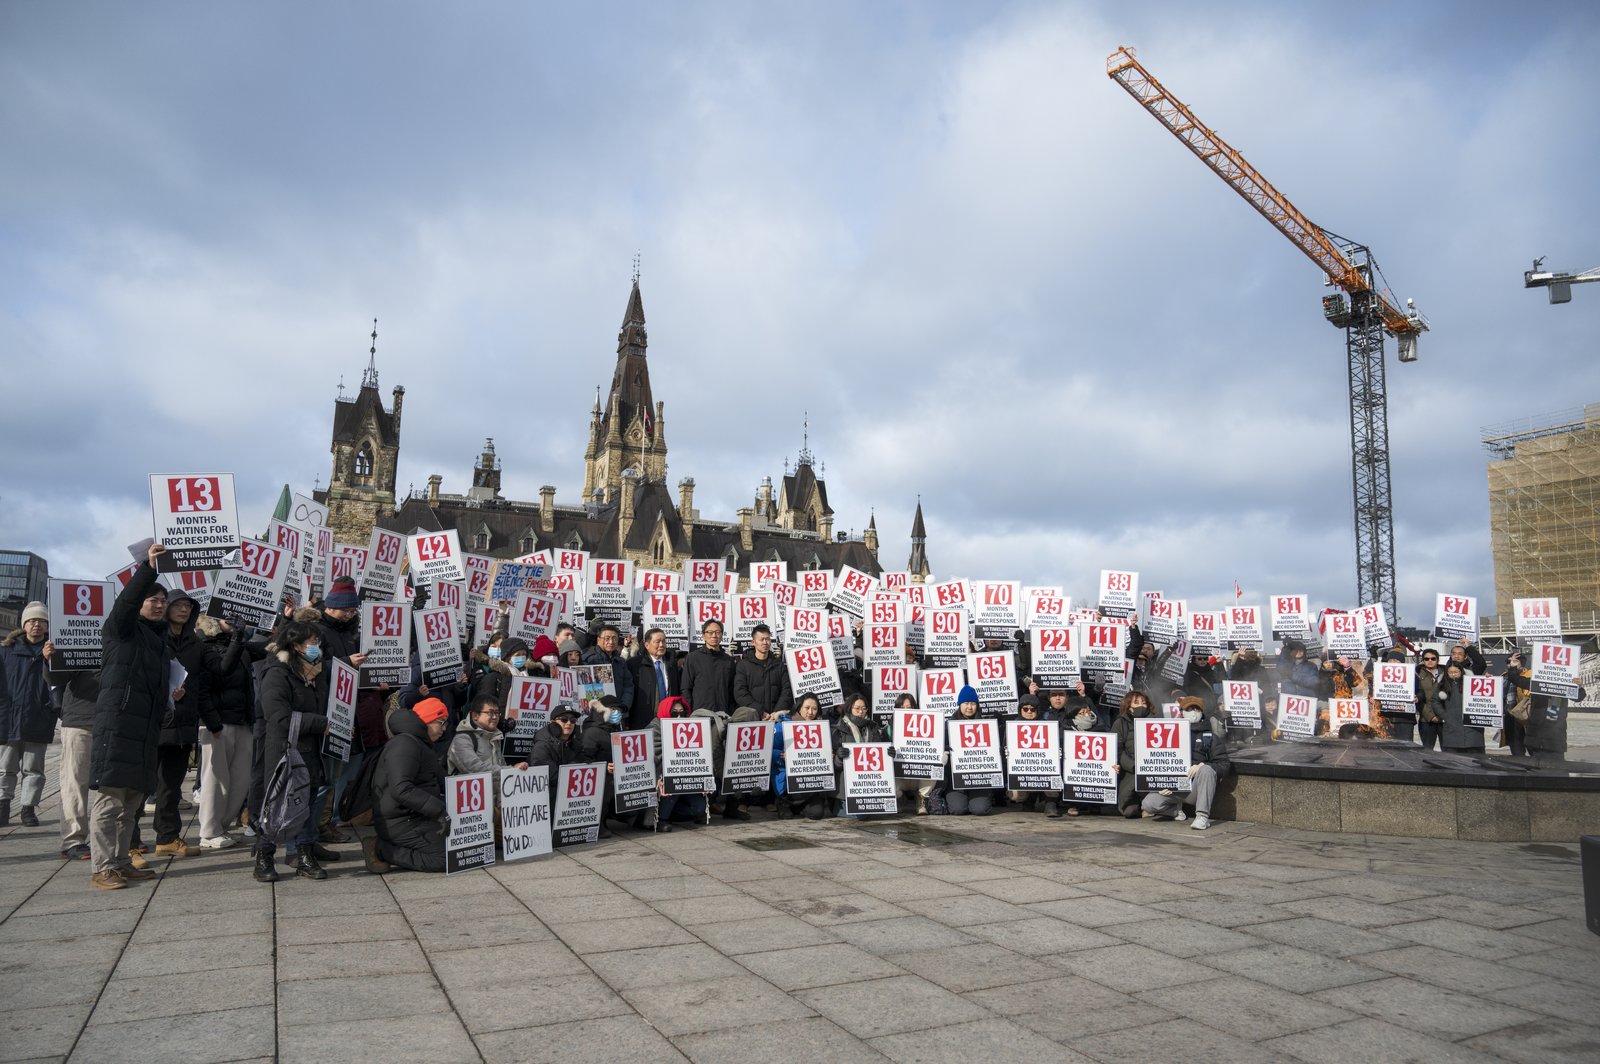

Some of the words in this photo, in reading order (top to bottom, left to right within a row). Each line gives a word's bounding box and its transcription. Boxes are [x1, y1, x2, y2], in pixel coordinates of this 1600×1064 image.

[175, 477, 214, 512] 13
[176, 515, 217, 524] MONTHS
[166, 526, 207, 535] WAITING
[209, 524, 228, 533] FOR
[161, 537, 183, 546] IRCC
[184, 534, 234, 545] RESPONSE
[319, 532, 329, 556] 20
[378, 536, 399, 563] 36
[422, 535, 448, 559] 42
[172, 551, 185, 559] NO
[176, 559, 188, 567] NO
[240, 543, 277, 577] 30
[424, 560, 449, 568] MONTHS
[564, 553, 581, 569] 31
[419, 567, 444, 576] WAITING
[500, 564, 522, 575] STOP
[525, 566, 543, 577] THE
[600, 563, 620, 583] 11
[695, 563, 716, 581] 53
[759, 566, 778, 582] 25
[224, 580, 257, 594] WAITING
[257, 588, 273, 598] FOR
[235, 574, 268, 588] MONTHS
[648, 574, 669, 590] 15
[806, 574, 826, 590] 33
[847, 572, 869, 595] 33
[889, 575, 904, 588] 20
[1110, 573, 1128, 590] 38
[76, 585, 91, 615] 8
[217, 587, 235, 598] IRCC
[235, 592, 275, 607] RESPONSE
[441, 583, 458, 608] 40
[776, 585, 793, 604] 68
[941, 584, 962, 604] 33
[987, 584, 1009, 603] 70
[527, 599, 549, 624] 54
[654, 595, 676, 615] 71
[702, 602, 723, 622] 53
[743, 598, 764, 618] 63
[875, 603, 895, 622] 55
[1038, 599, 1061, 614] 35
[1152, 600, 1169, 617] 32
[1279, 598, 1300, 613] 31
[1447, 597, 1466, 613] 37
[1526, 601, 1546, 618] 11
[68, 619, 100, 627] MONTHS
[375, 606, 399, 635] 34
[426, 611, 448, 640] 38
[797, 611, 818, 631] 68
[936, 612, 956, 632] 90
[1194, 615, 1212, 630] 37
[1234, 609, 1253, 623] 37
[1336, 617, 1356, 632] 34
[874, 628, 895, 647] 34
[1043, 629, 1066, 650] 22
[1093, 626, 1112, 647] 11
[799, 648, 825, 672] 39
[1545, 646, 1567, 665] 14
[979, 656, 1002, 678] 65
[1385, 666, 1403, 682] 39
[338, 667, 353, 704] 37
[884, 670, 906, 689] 40
[929, 673, 953, 693] 72
[1473, 678, 1491, 696] 25
[524, 683, 548, 710] 42
[1232, 683, 1249, 699] 23
[1288, 699, 1309, 715] 20
[1338, 702, 1359, 718] 39
[906, 713, 931, 737] 40
[676, 722, 698, 748] 62
[739, 725, 761, 750] 81
[796, 724, 819, 749] 35
[963, 723, 986, 747] 51
[1020, 725, 1045, 748] 34
[1149, 723, 1175, 747] 37
[624, 734, 643, 763] 31
[1078, 735, 1103, 760] 36
[856, 747, 880, 770] 43
[680, 765, 709, 773] RESPONSE
[502, 775, 549, 797] CANADA
[569, 767, 595, 797] 36
[460, 778, 481, 813] 18
[568, 799, 590, 808] MONTHS
[503, 806, 530, 828] WHAT
[530, 805, 548, 824] ARE
[557, 818, 569, 826] IRCC
[569, 814, 597, 824] RESPONSE
[561, 808, 583, 817] WAITING
[584, 806, 595, 814] FOR
